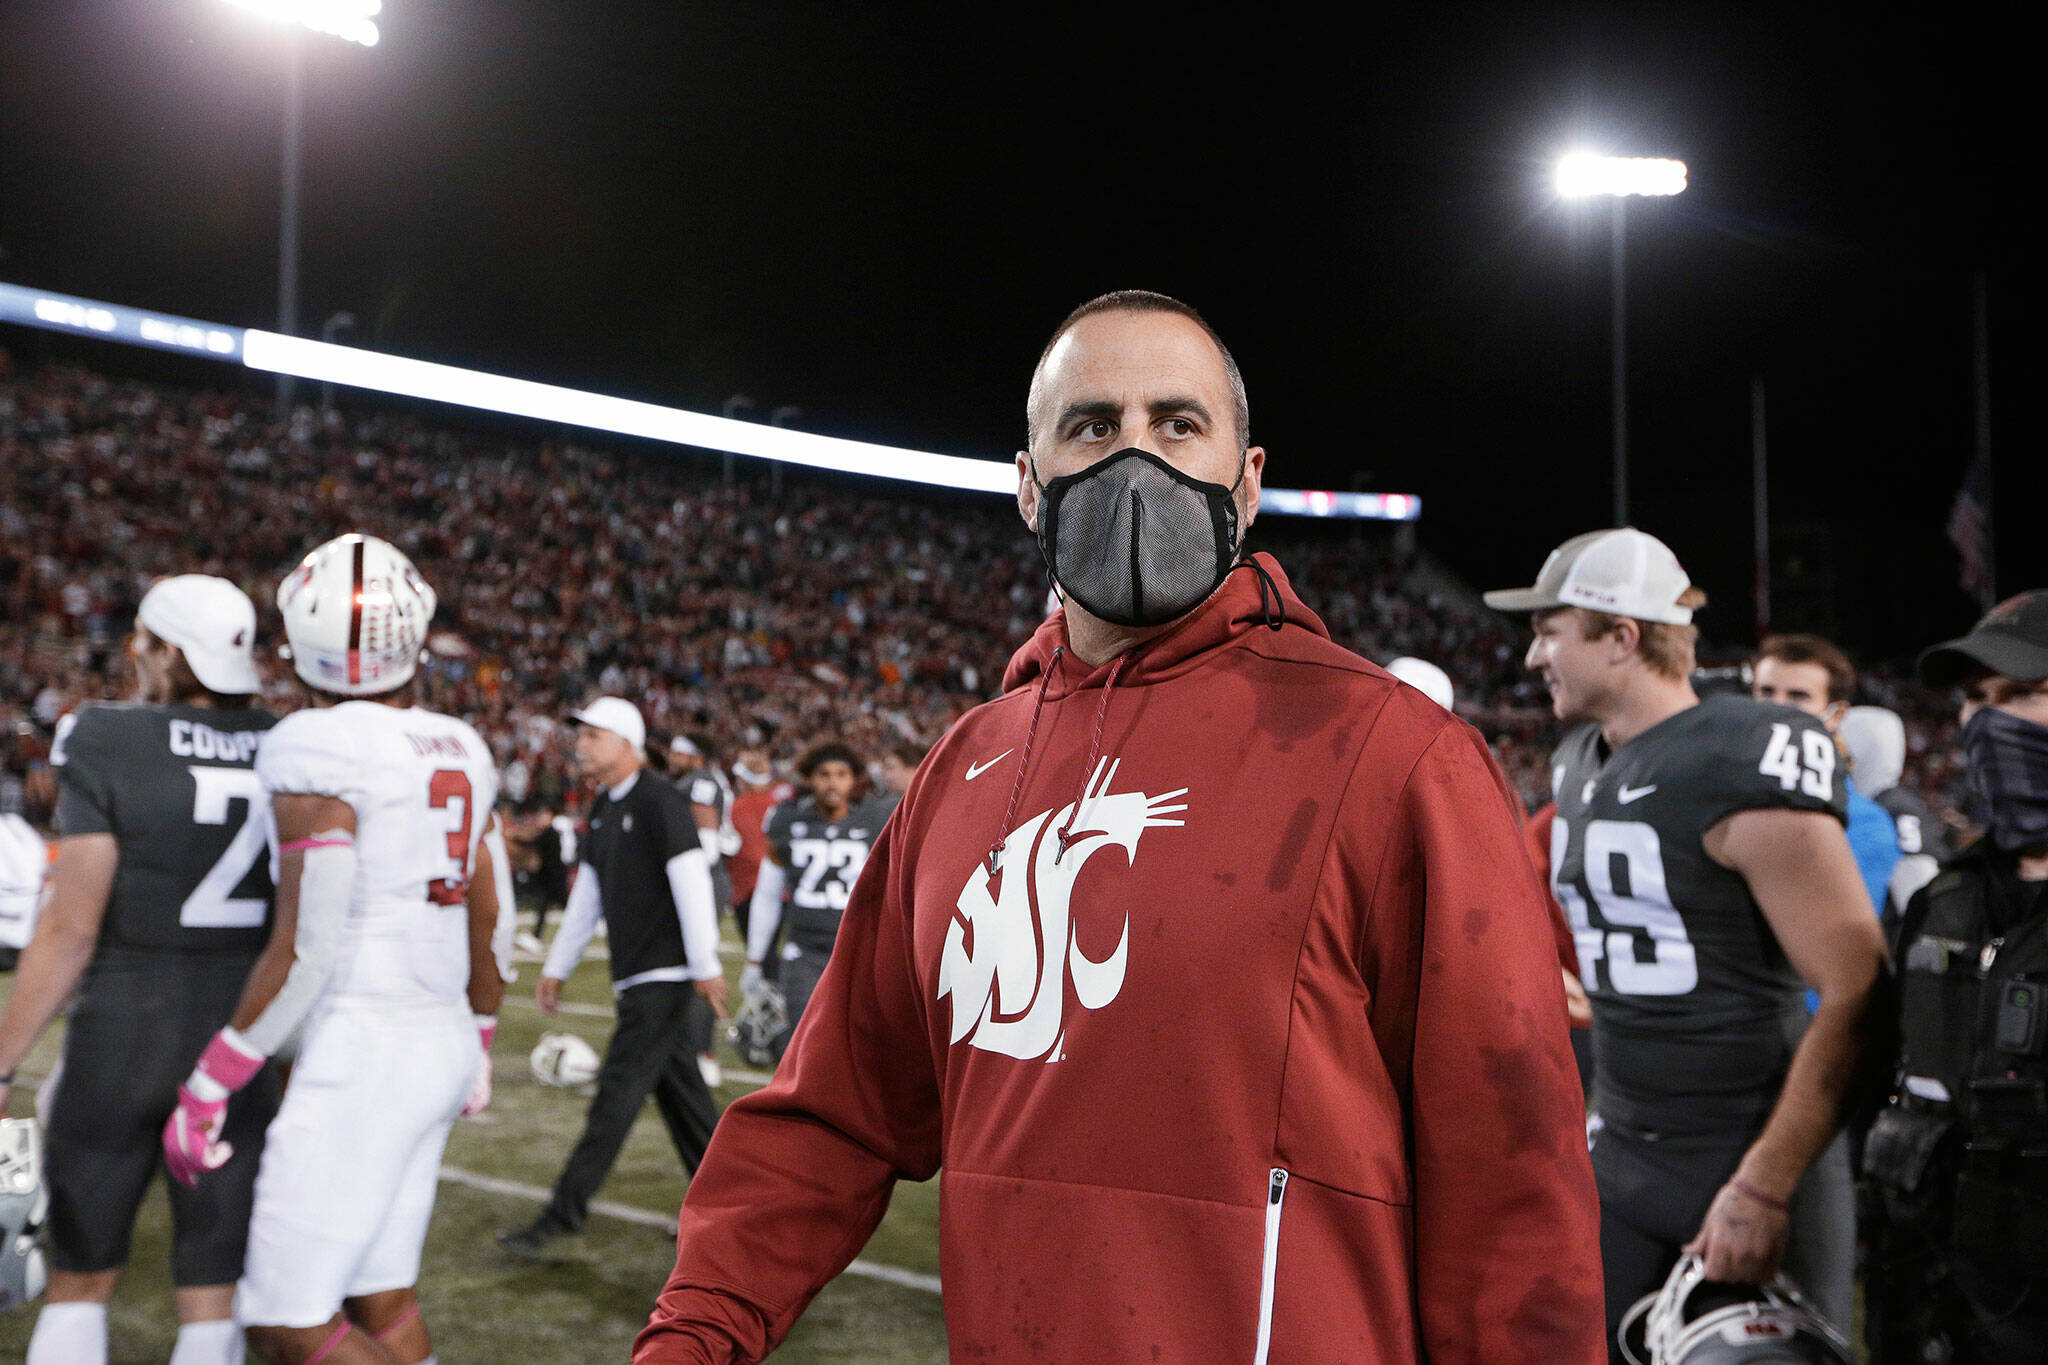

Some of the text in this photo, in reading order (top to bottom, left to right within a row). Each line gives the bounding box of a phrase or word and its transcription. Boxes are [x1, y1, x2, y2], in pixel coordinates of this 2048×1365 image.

[1759, 722, 1835, 801] 49
[180, 765, 269, 928] 2
[427, 769, 472, 907] 3
[789, 838, 870, 909] 23
[1551, 816, 1698, 996] 49
